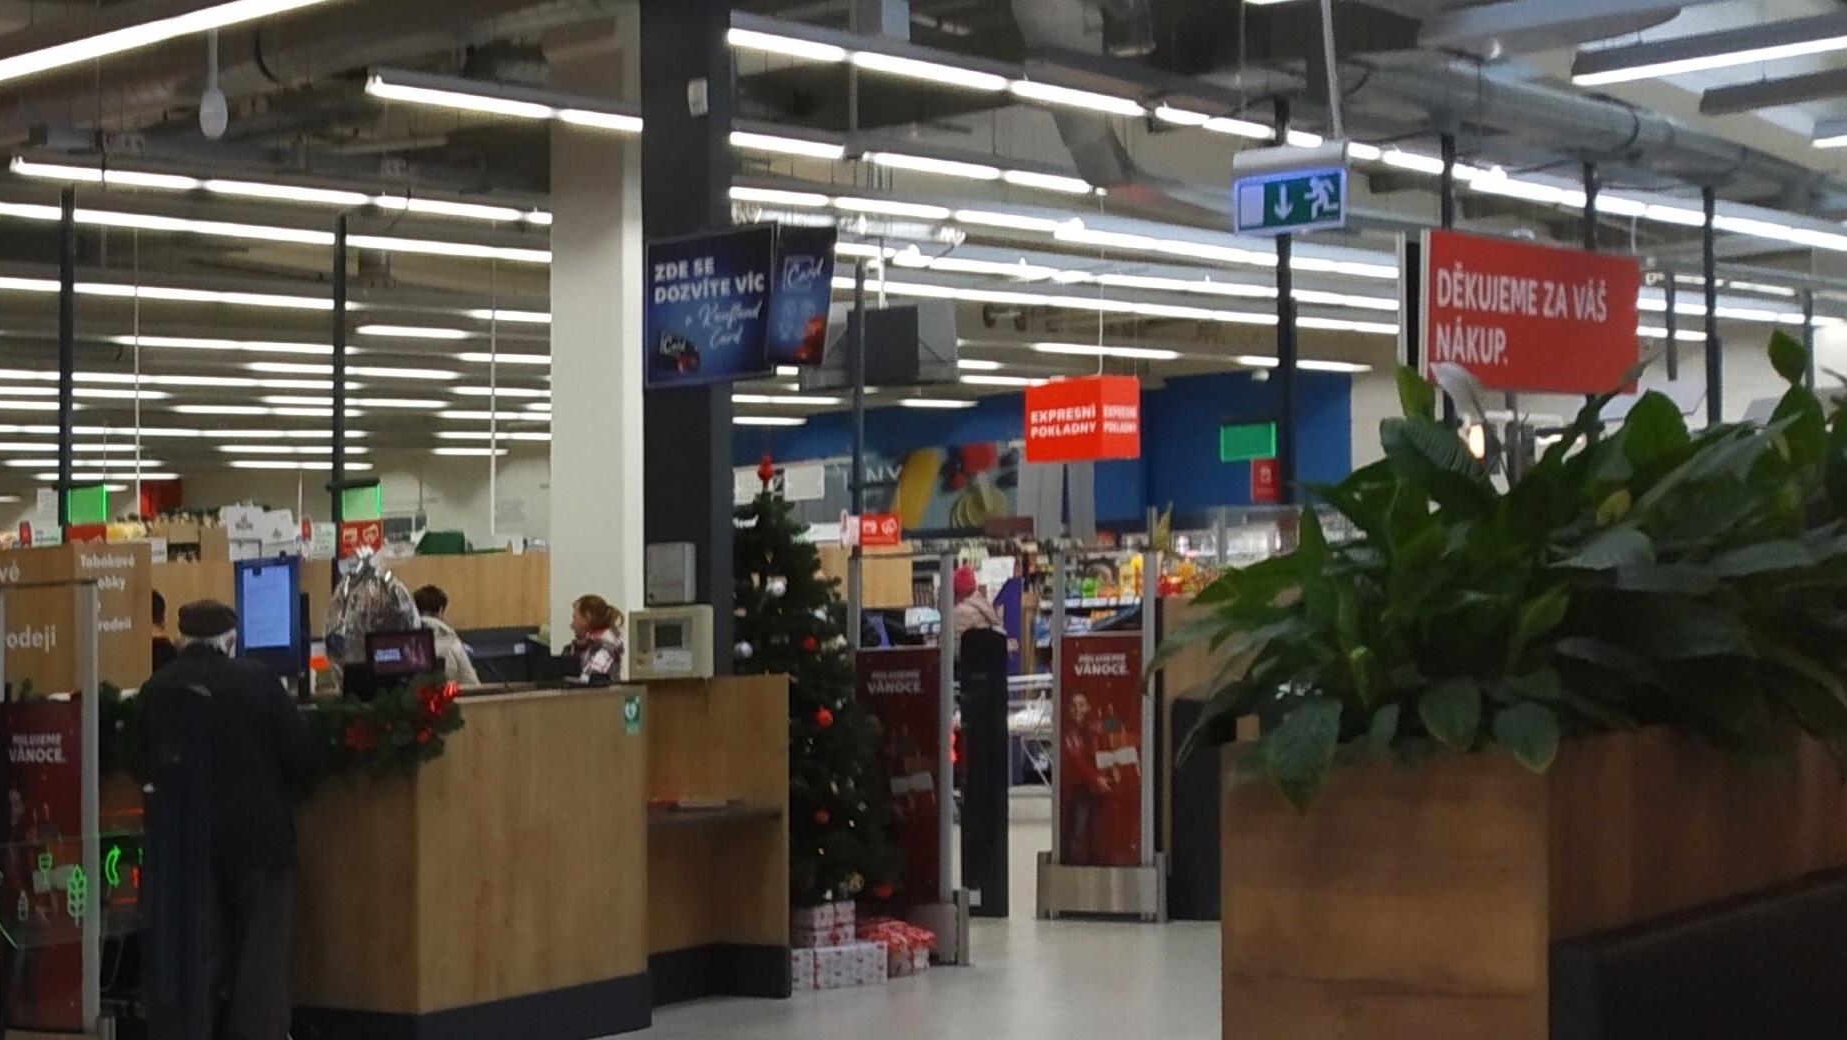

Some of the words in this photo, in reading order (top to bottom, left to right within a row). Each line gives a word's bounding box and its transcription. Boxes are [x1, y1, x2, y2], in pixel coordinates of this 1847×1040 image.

[654, 259, 688, 283] ZDE
[693, 257, 714, 278] SE
[654, 278, 730, 304] DOZVÍTE
[735, 270, 765, 295] VÍC
[1436, 261, 1538, 316] DĚKUJEME
[1542, 279, 1568, 319] ZA
[1572, 278, 1607, 322] VÁŠ
[1435, 316, 1509, 365] NÁKUP.
[1030, 404, 1096, 424] EXPRESNÍ
[1030, 421, 1097, 439] POKLADNY
[6, 624, 57, 653] odeji
